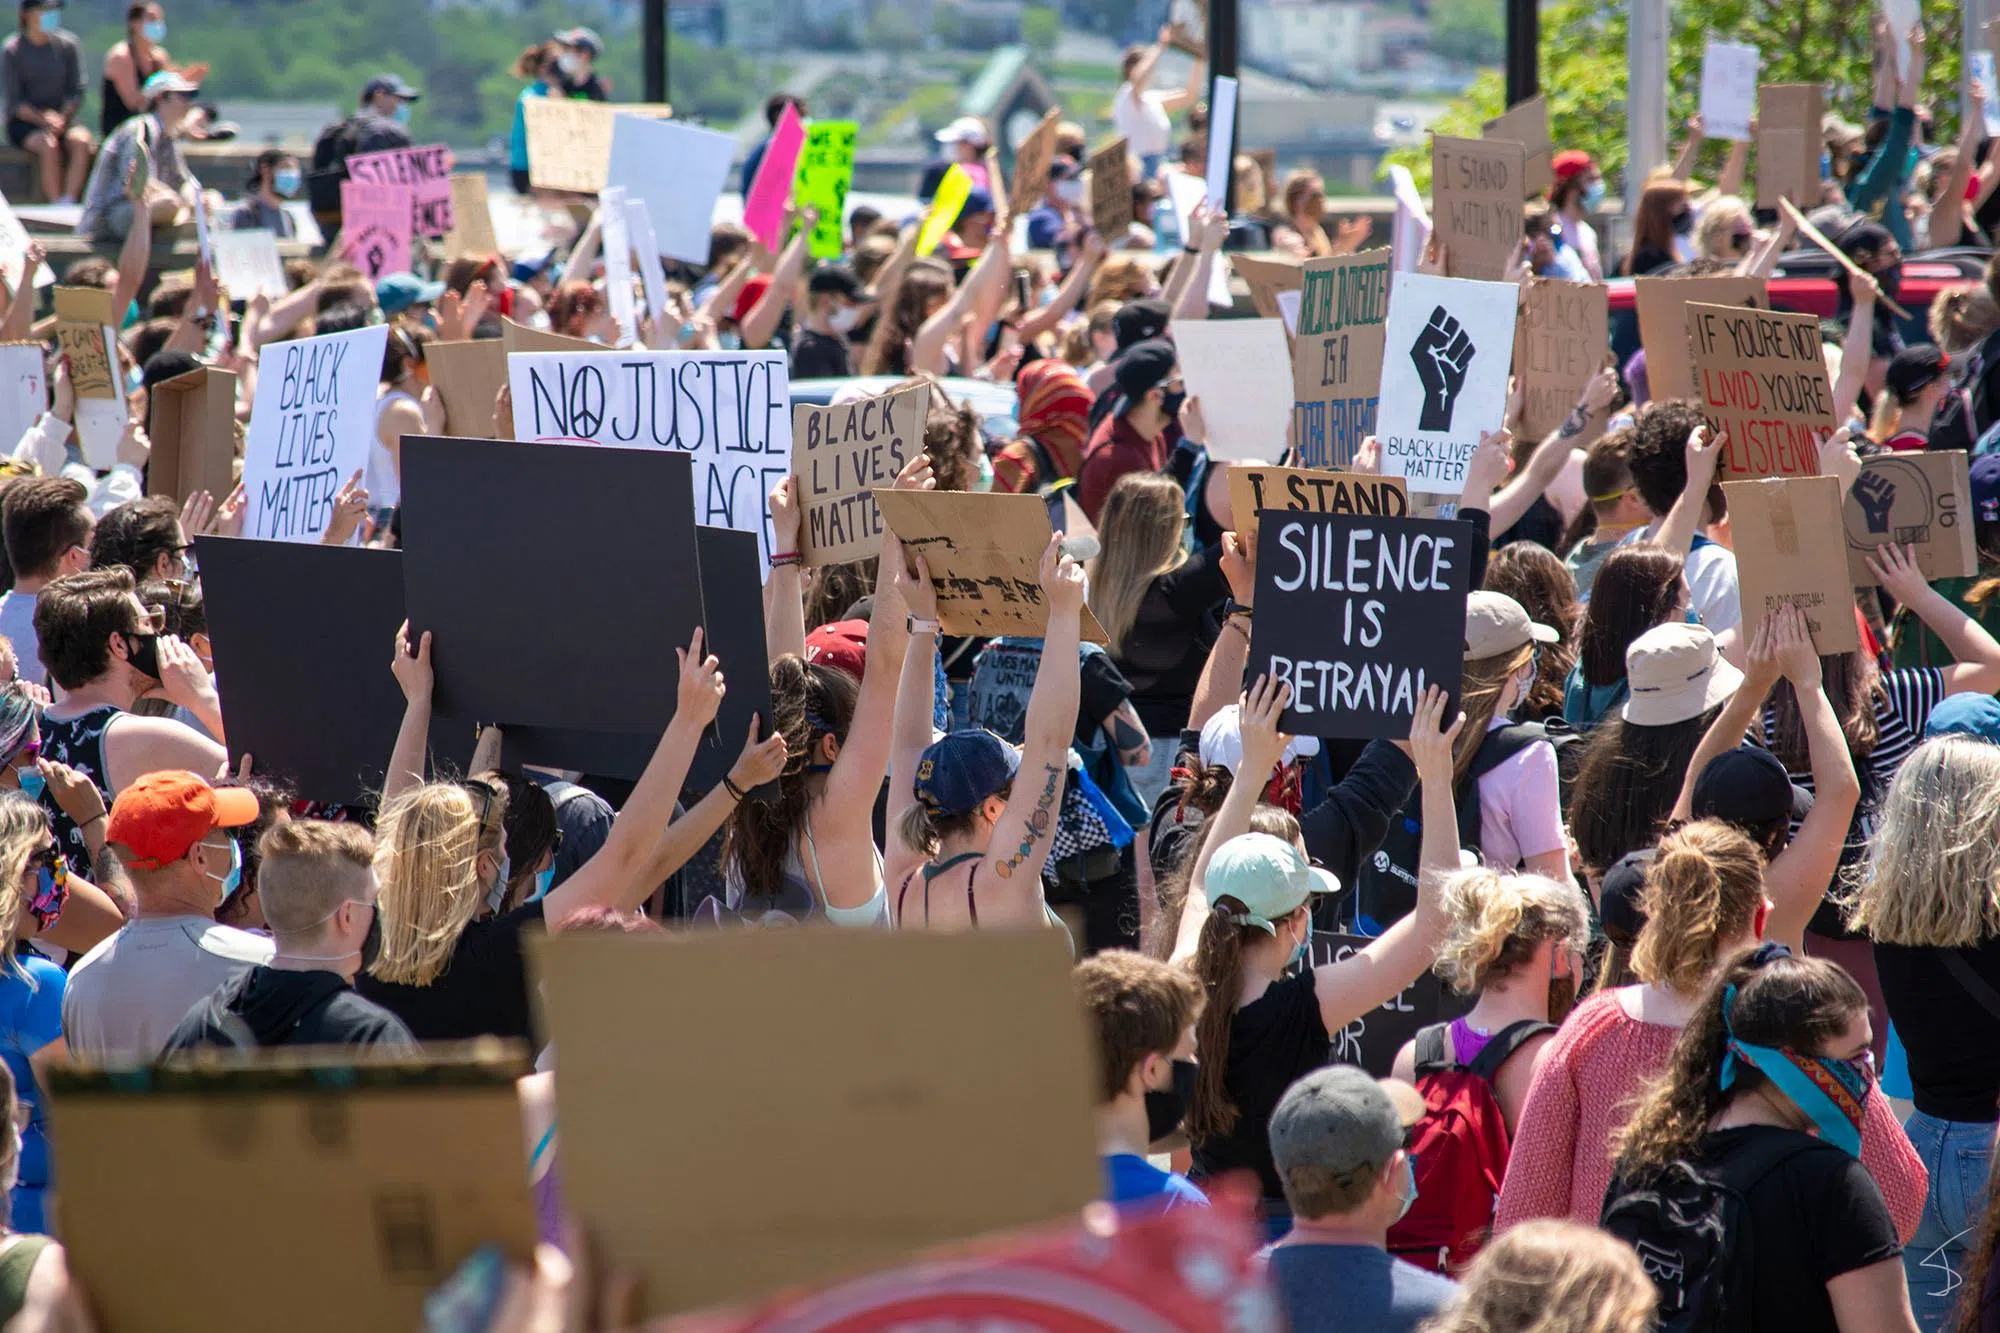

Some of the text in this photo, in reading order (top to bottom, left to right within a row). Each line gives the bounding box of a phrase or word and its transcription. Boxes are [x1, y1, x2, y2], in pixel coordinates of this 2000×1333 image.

[353, 148, 446, 186] SILENCE
[1441, 151, 1509, 191] I STAND
[411, 196, 452, 237] ENCE
[1448, 199, 1489, 241] WITH
[1530, 291, 1592, 335] BLACK
[1321, 338, 1337, 387] IS
[1339, 334, 1349, 384] A
[1531, 334, 1592, 377] LIVES
[1696, 313, 1819, 363] IF YOU'RE NOT
[279, 340, 350, 411] BLACK
[1761, 370, 1831, 416] YOU'RE
[529, 359, 787, 455] NO JUSTICE
[807, 396, 896, 451] BLACK
[275, 408, 338, 469] LIVES
[1387, 435, 1435, 459] BLACK
[812, 437, 906, 496] LIVES
[1403, 459, 1465, 482] MATTER
[256, 466, 339, 540] MATTER
[691, 458, 787, 566] ACE
[808, 489, 884, 550] MATTE
[1247, 472, 1408, 519] I STAND
[1273, 521, 1455, 593] SILENCE
[1343, 598, 1386, 648] IS
[991, 654, 1018, 670] LIVES
[995, 671, 1035, 688] UNTIL
